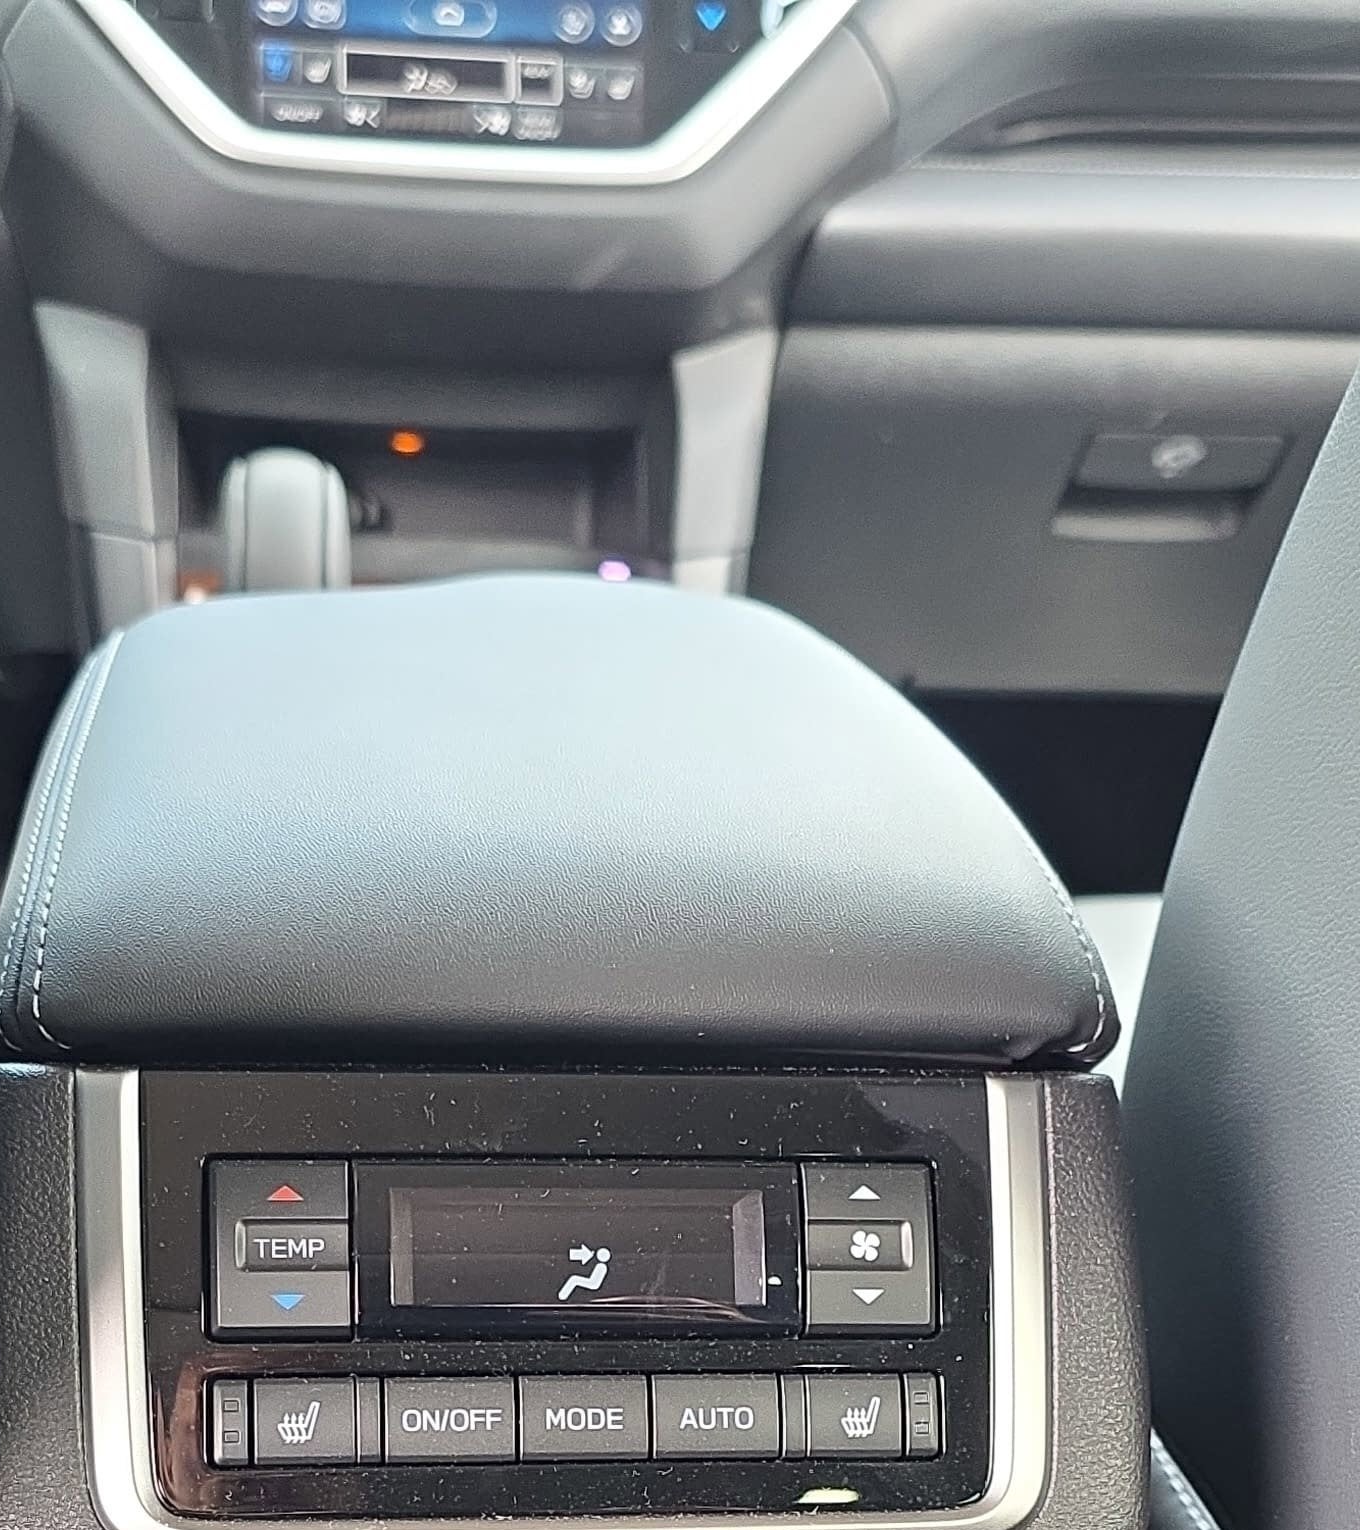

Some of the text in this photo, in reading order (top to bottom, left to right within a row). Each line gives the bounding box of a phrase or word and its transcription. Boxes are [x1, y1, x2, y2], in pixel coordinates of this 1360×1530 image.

[253, 1238, 325, 1259] TEMP
[401, 1407, 502, 1432] ON/OFF
[545, 1407, 624, 1431] MODE
[679, 1406, 754, 1430] AUTO
